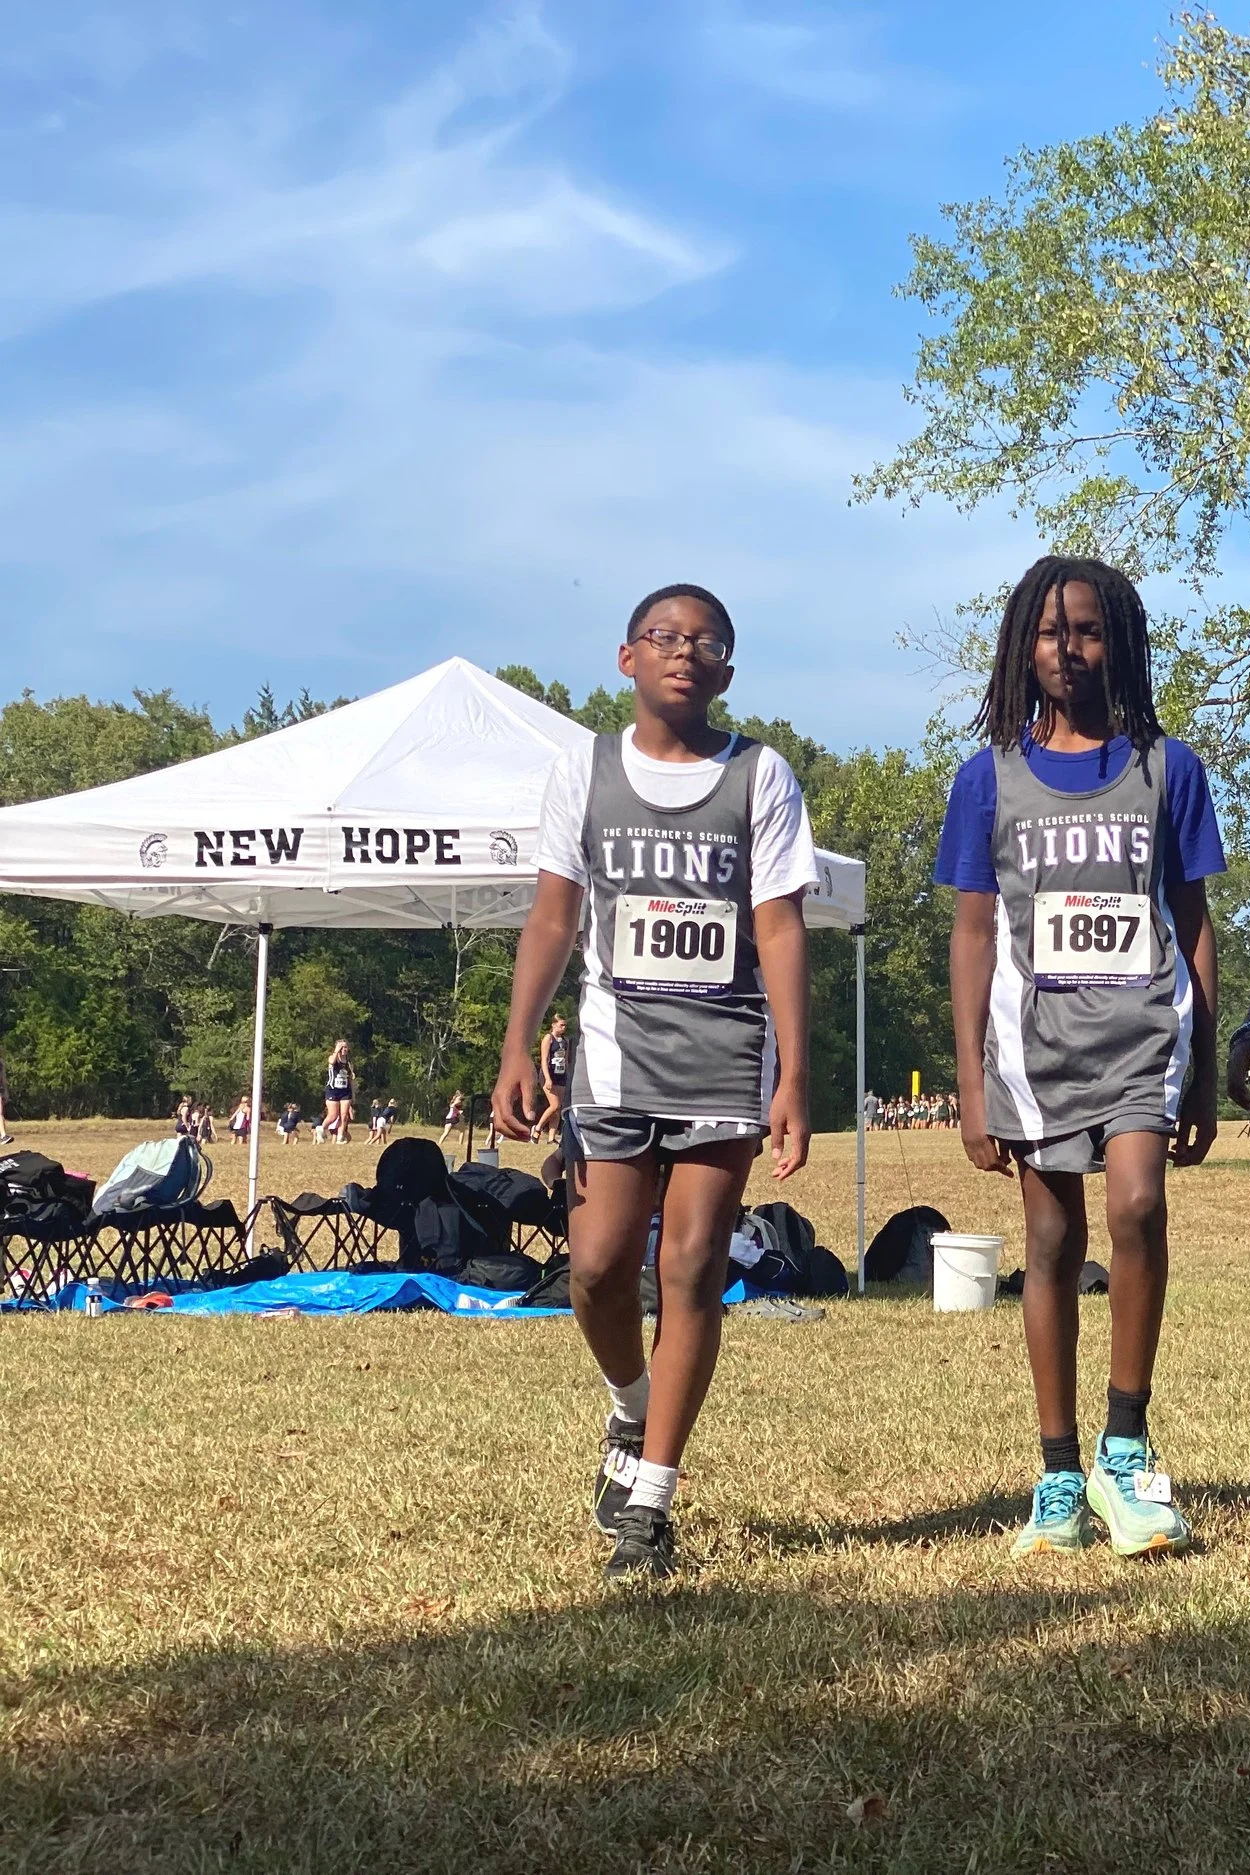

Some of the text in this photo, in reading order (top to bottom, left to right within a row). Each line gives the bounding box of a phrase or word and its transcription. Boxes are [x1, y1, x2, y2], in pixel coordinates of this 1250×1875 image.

[699, 832, 739, 845] SCHOOL
[1016, 819, 1033, 831] THE
[1110, 813, 1150, 824] SCHOOL
[194, 826, 461, 867] NEW HOPE
[602, 840, 738, 883] LIONS
[1017, 825, 1150, 872] LIONS
[648, 900, 707, 916] MileSplit
[1064, 895, 1122, 910] MileSplit
[629, 918, 725, 961] 1900
[1047, 913, 1140, 953] 1897
